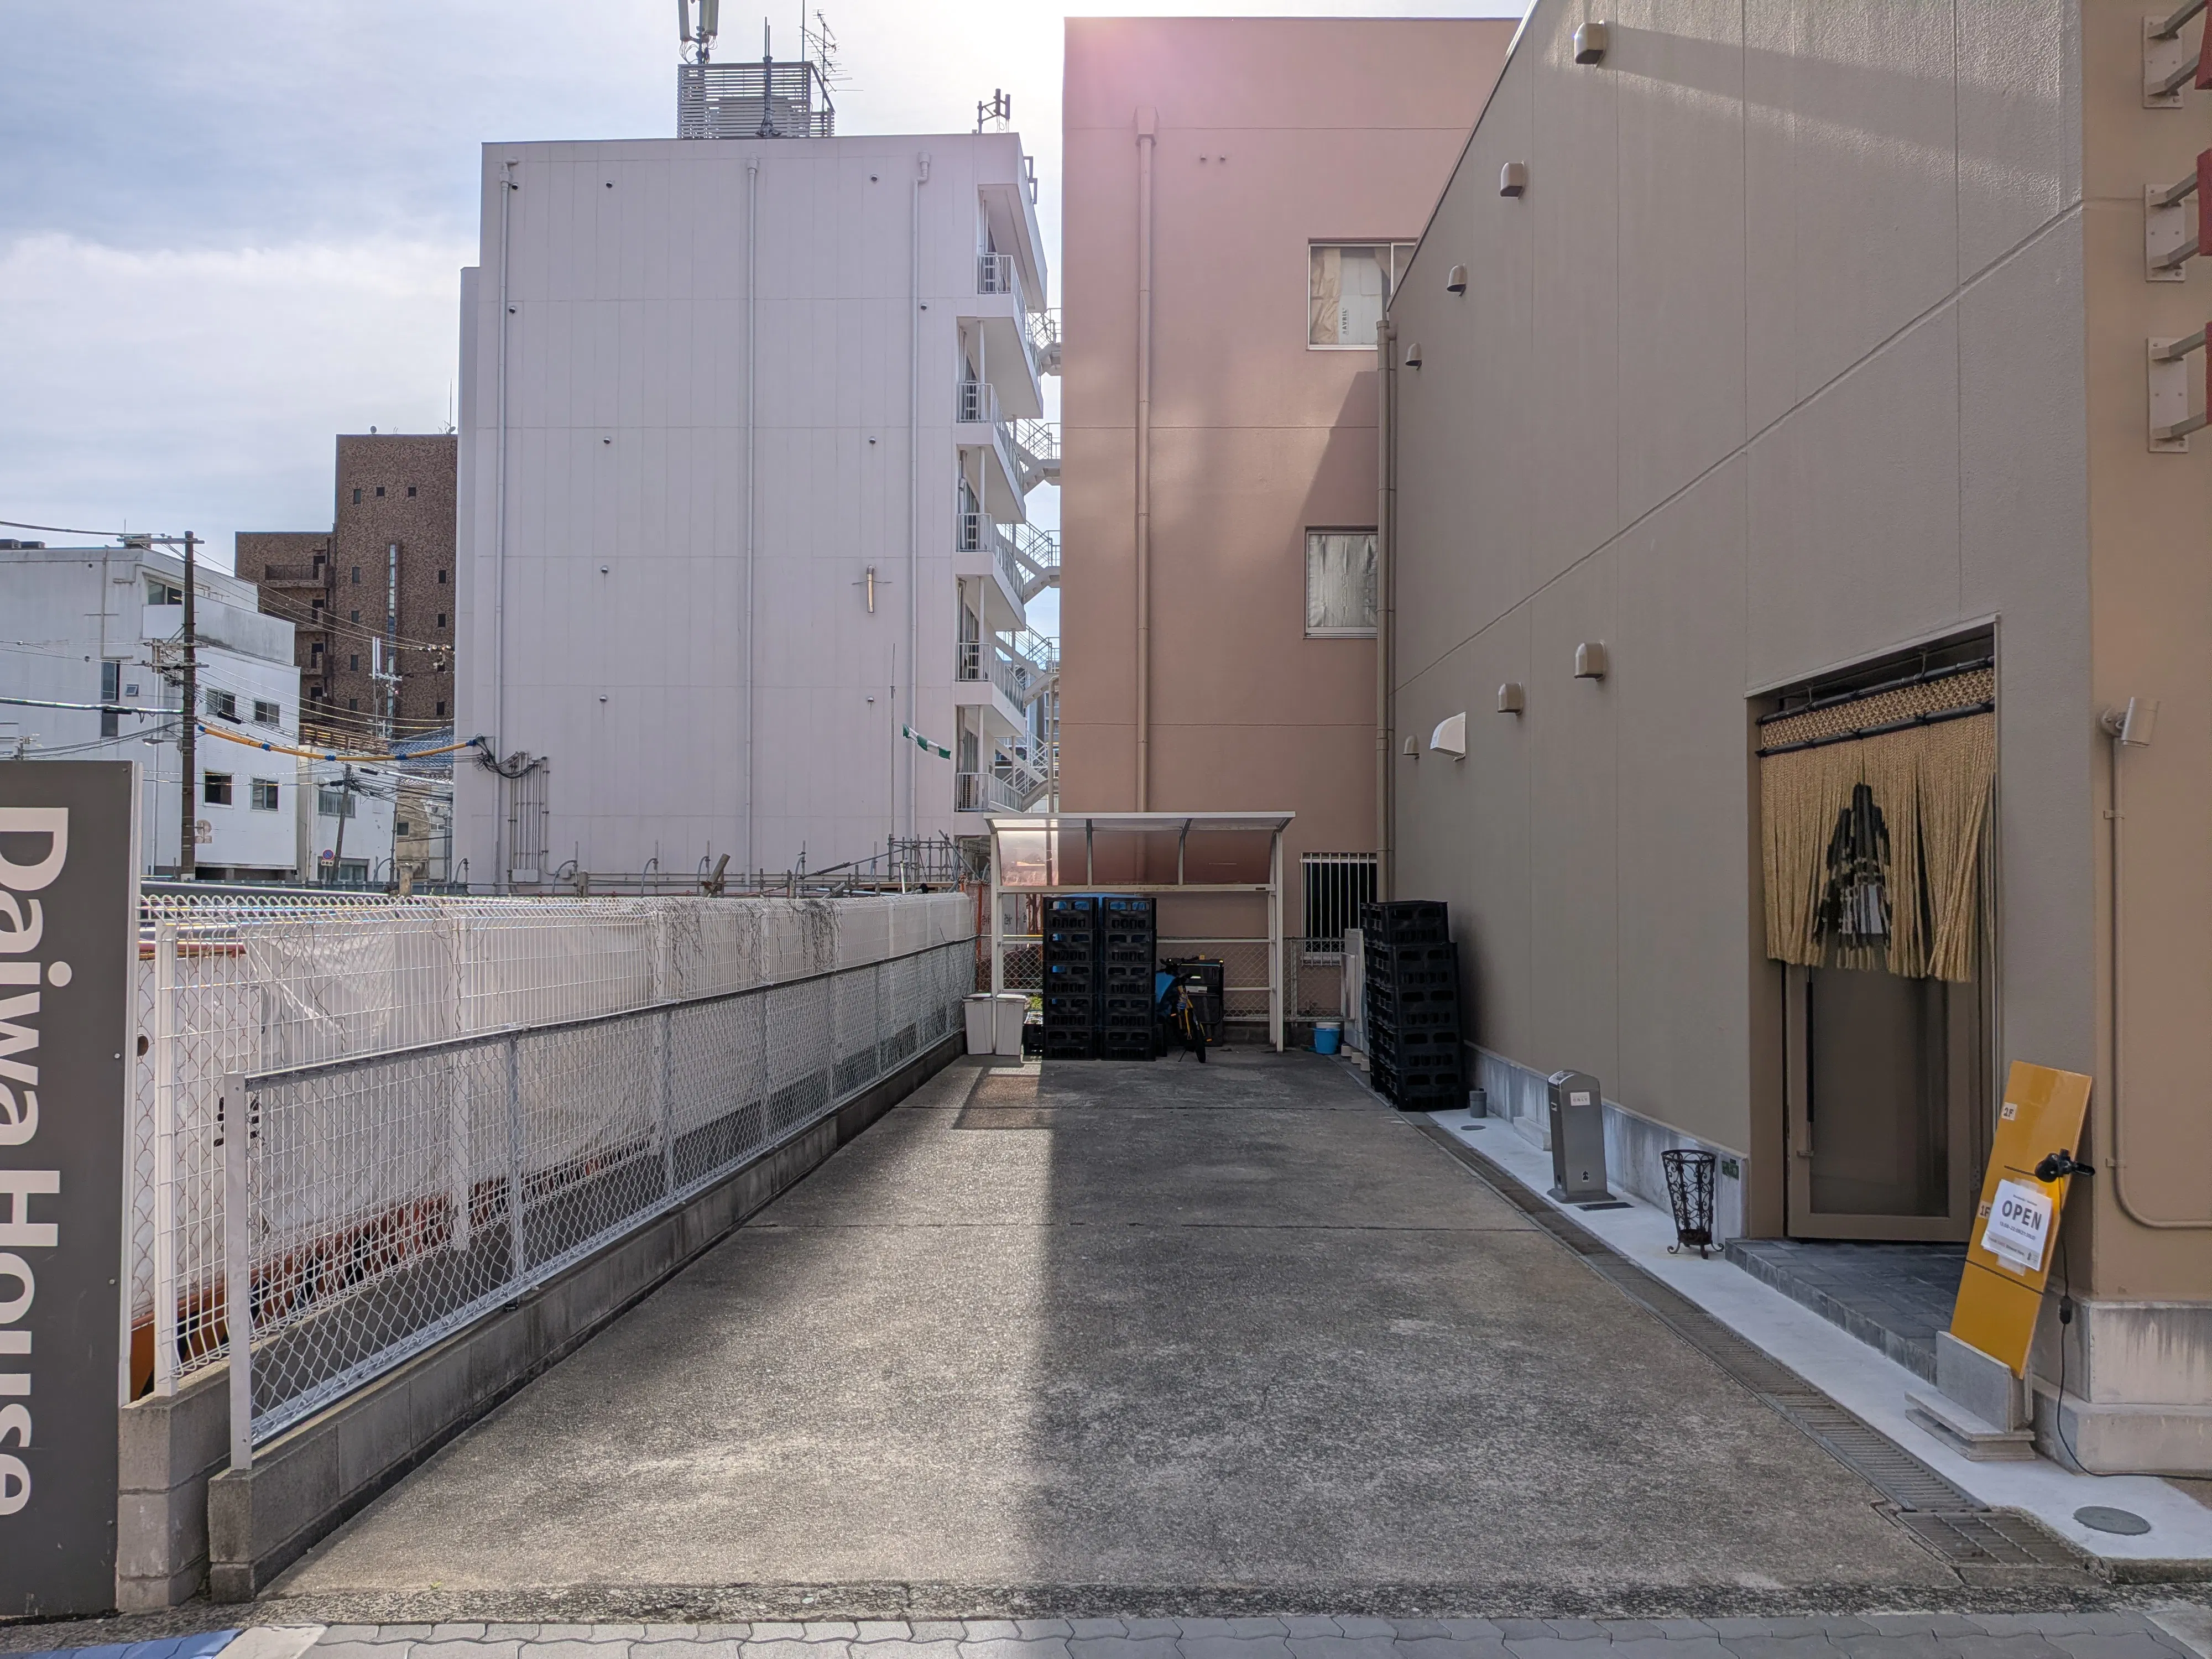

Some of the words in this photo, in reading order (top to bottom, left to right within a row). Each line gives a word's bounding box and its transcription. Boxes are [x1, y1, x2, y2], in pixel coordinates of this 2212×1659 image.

[0, 806, 72, 1147] Daiwa
[0, 1170, 60, 1515] House
[2001, 1199, 2042, 1231] OPEN
